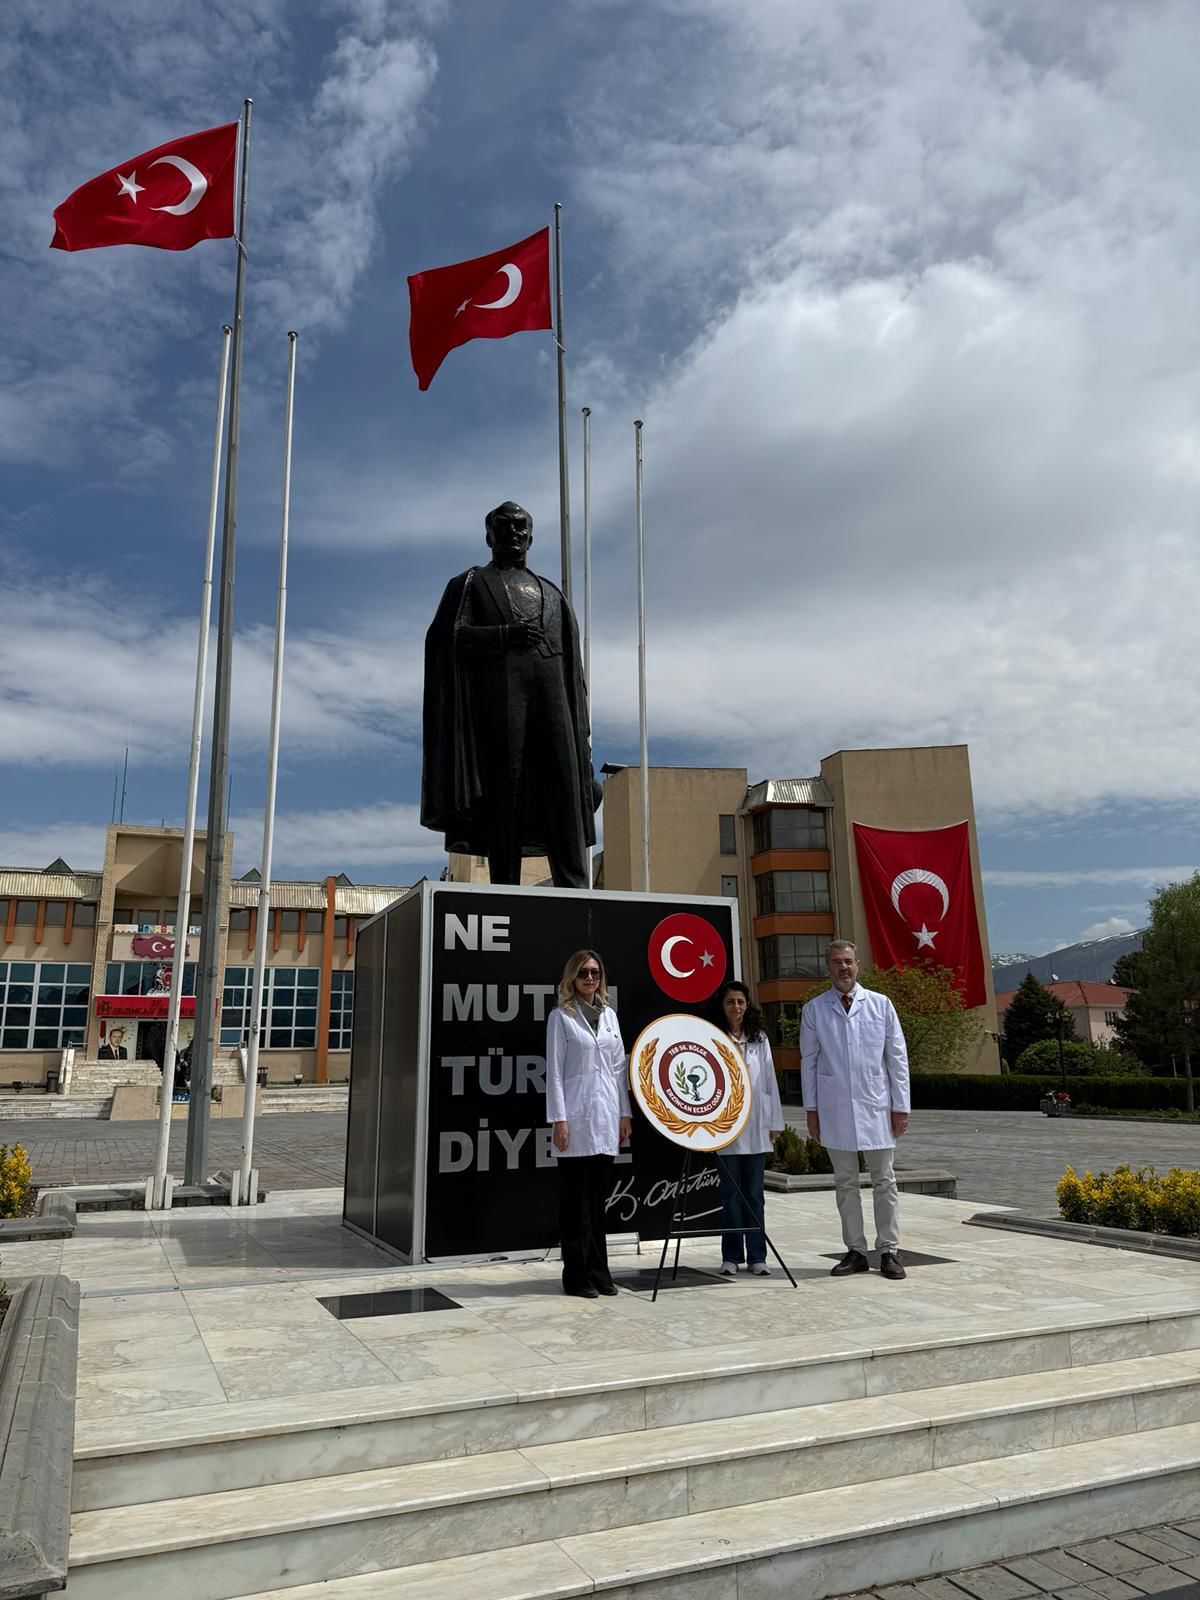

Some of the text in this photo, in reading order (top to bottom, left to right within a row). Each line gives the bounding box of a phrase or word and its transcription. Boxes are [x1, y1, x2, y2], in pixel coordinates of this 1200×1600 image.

[445, 913, 511, 952] NE
[443, 984, 618, 1022] MUT
[669, 1046, 680, 1056] TEB
[689, 1045, 708, 1056] BÖLGE
[666, 1088, 722, 1113] ERZİNCAN ECZACI ODASI
[439, 1118, 632, 1173] DİYE
